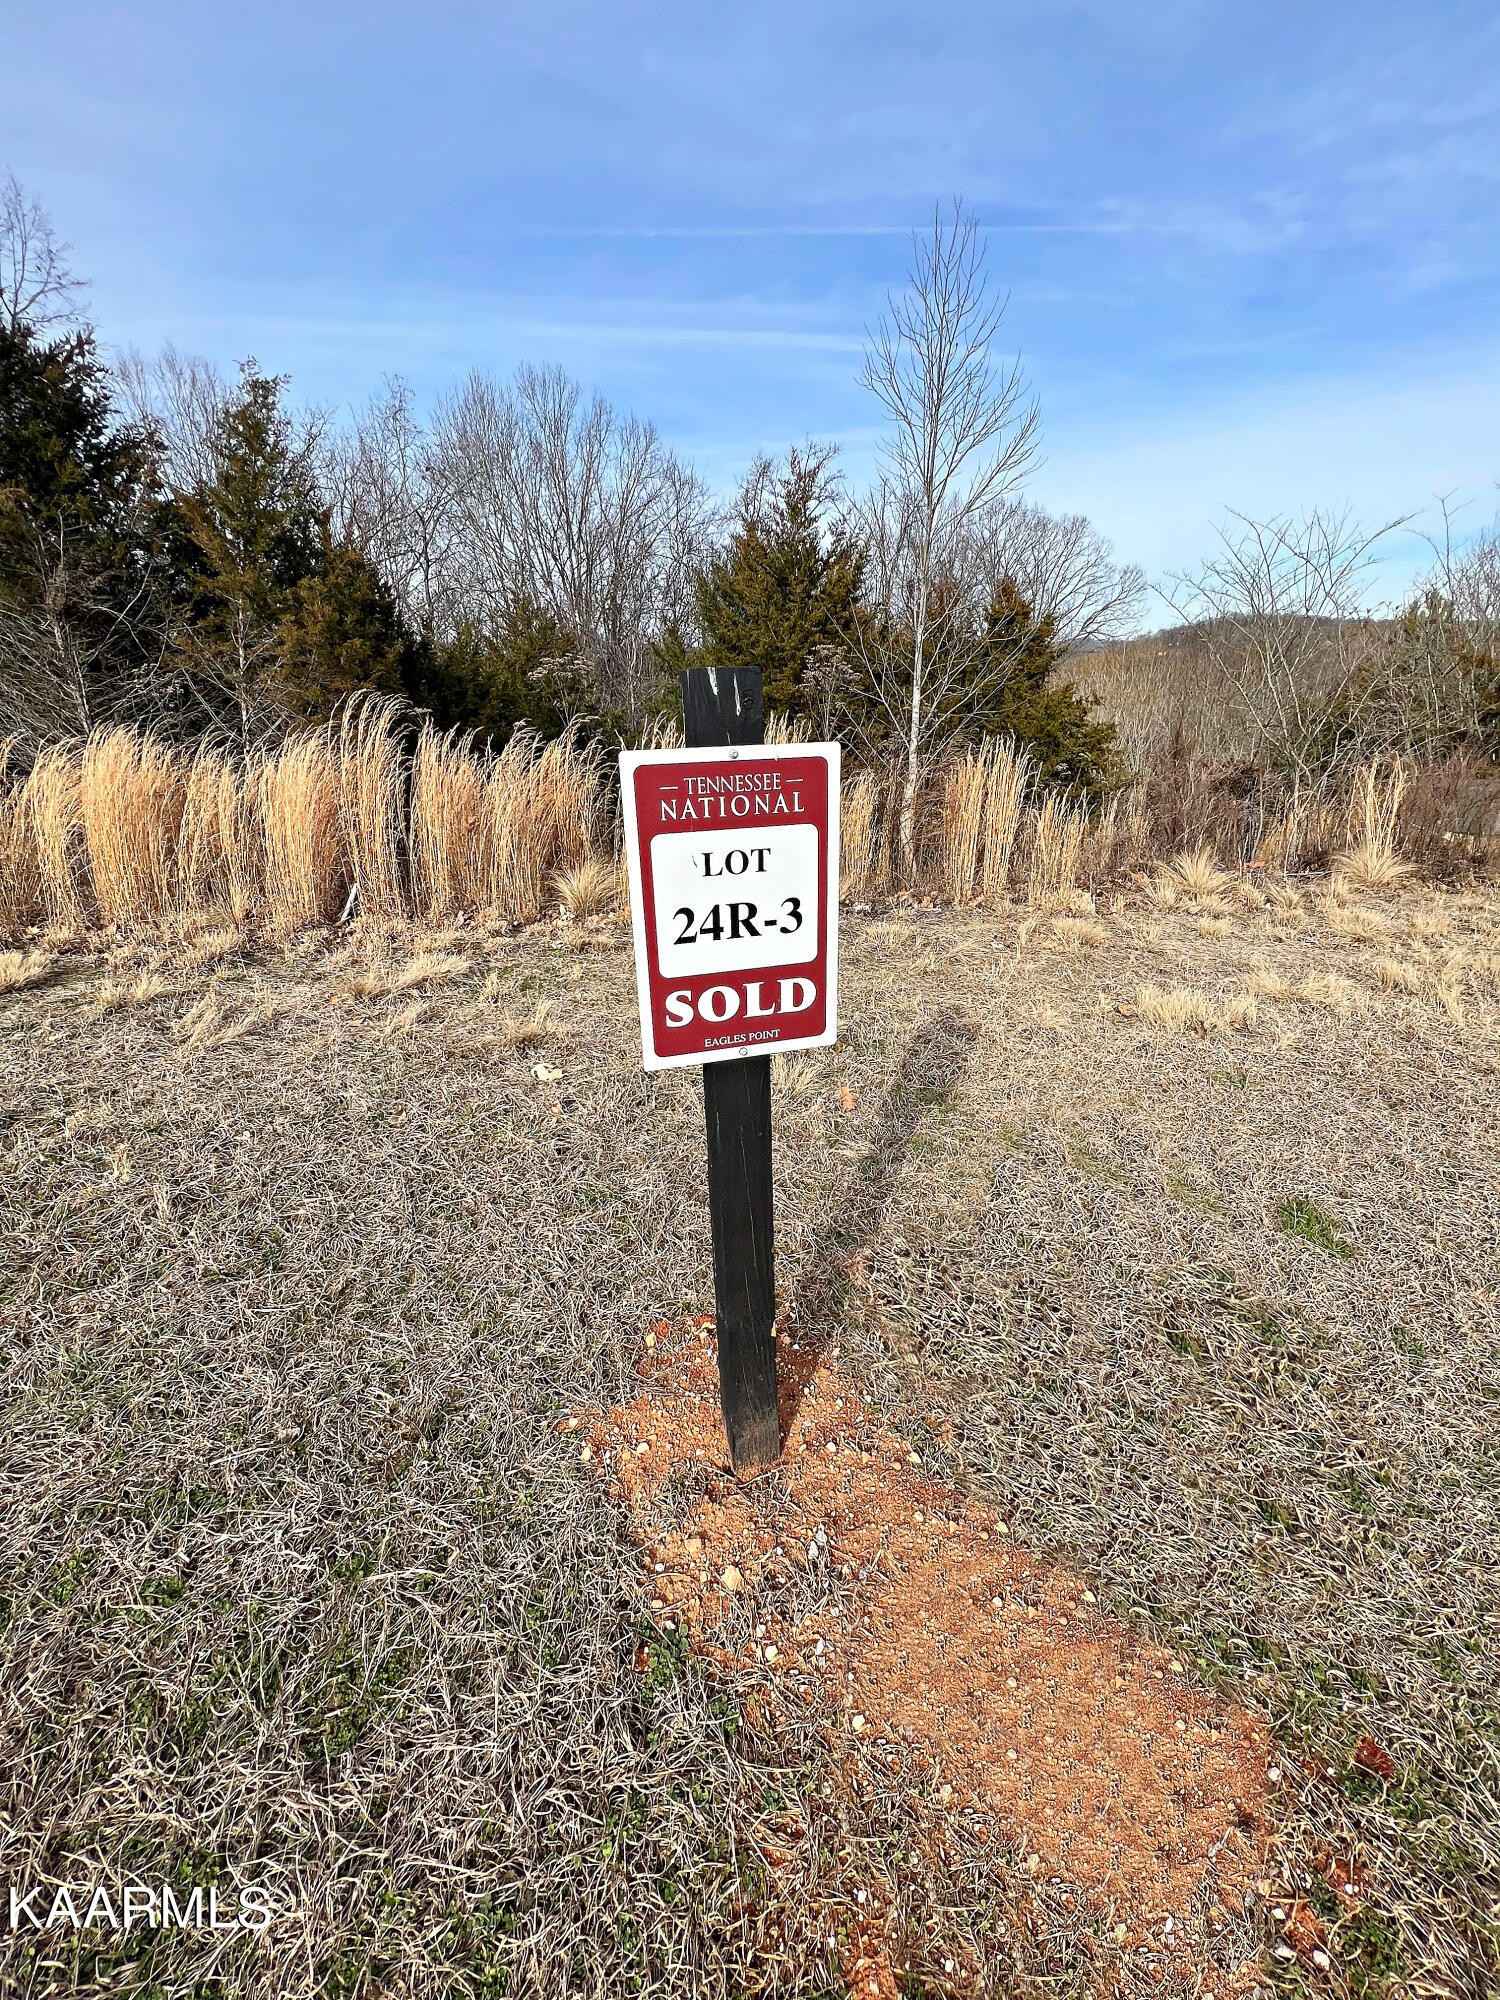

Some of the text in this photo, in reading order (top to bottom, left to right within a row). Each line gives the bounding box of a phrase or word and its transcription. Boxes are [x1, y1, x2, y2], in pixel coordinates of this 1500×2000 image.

[683, 772, 782, 795] TENNESSEE
[660, 791, 805, 822] NATIONAL
[701, 848, 771, 877] LOT
[672, 897, 803, 945] 24R-3
[665, 977, 817, 1028] SOLD
[704, 1028, 781, 1048] EAGLES POINT
